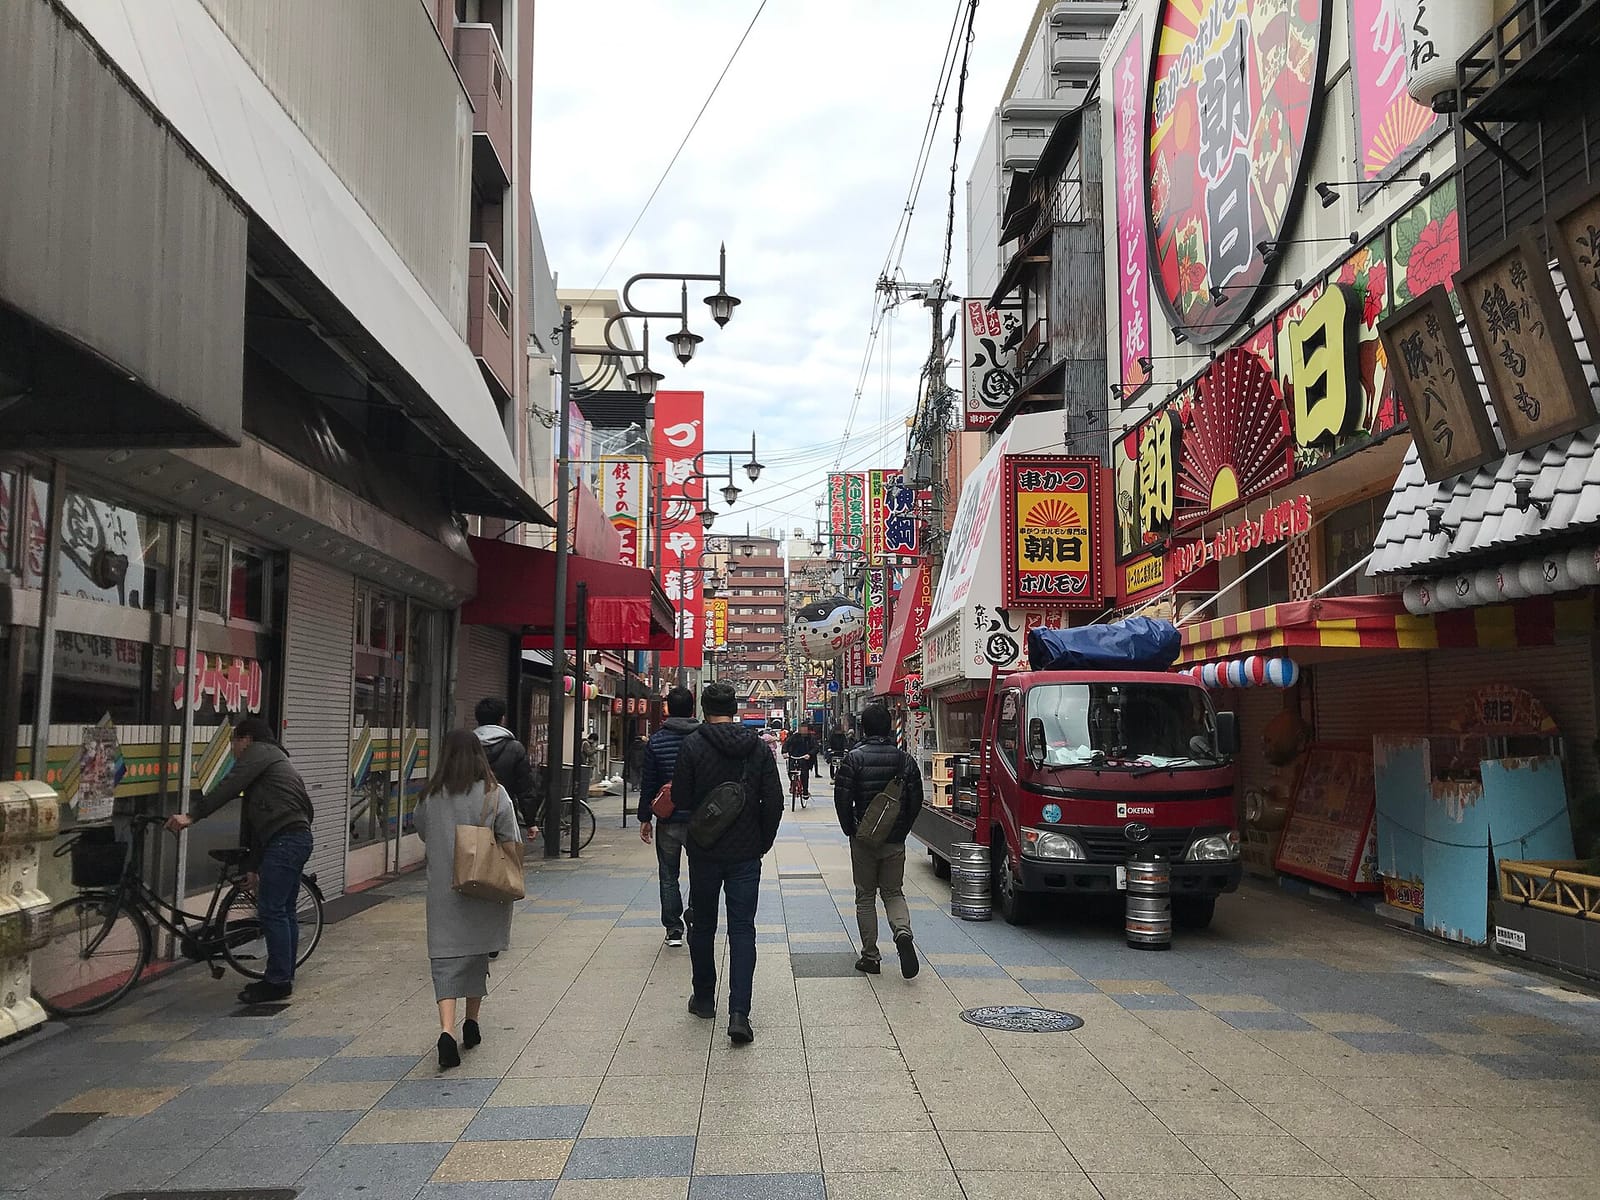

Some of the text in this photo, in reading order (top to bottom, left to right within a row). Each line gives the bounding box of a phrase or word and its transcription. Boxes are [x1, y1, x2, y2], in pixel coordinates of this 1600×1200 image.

[1410, 0, 1440, 71] くね
[1198, 14, 1252, 298] 朝日
[611, 462, 632, 513] 餃子の
[1019, 470, 1086, 491] 串かつ
[1024, 535, 1083, 563] 朝日
[1020, 574, 1088, 593] ホルモン
